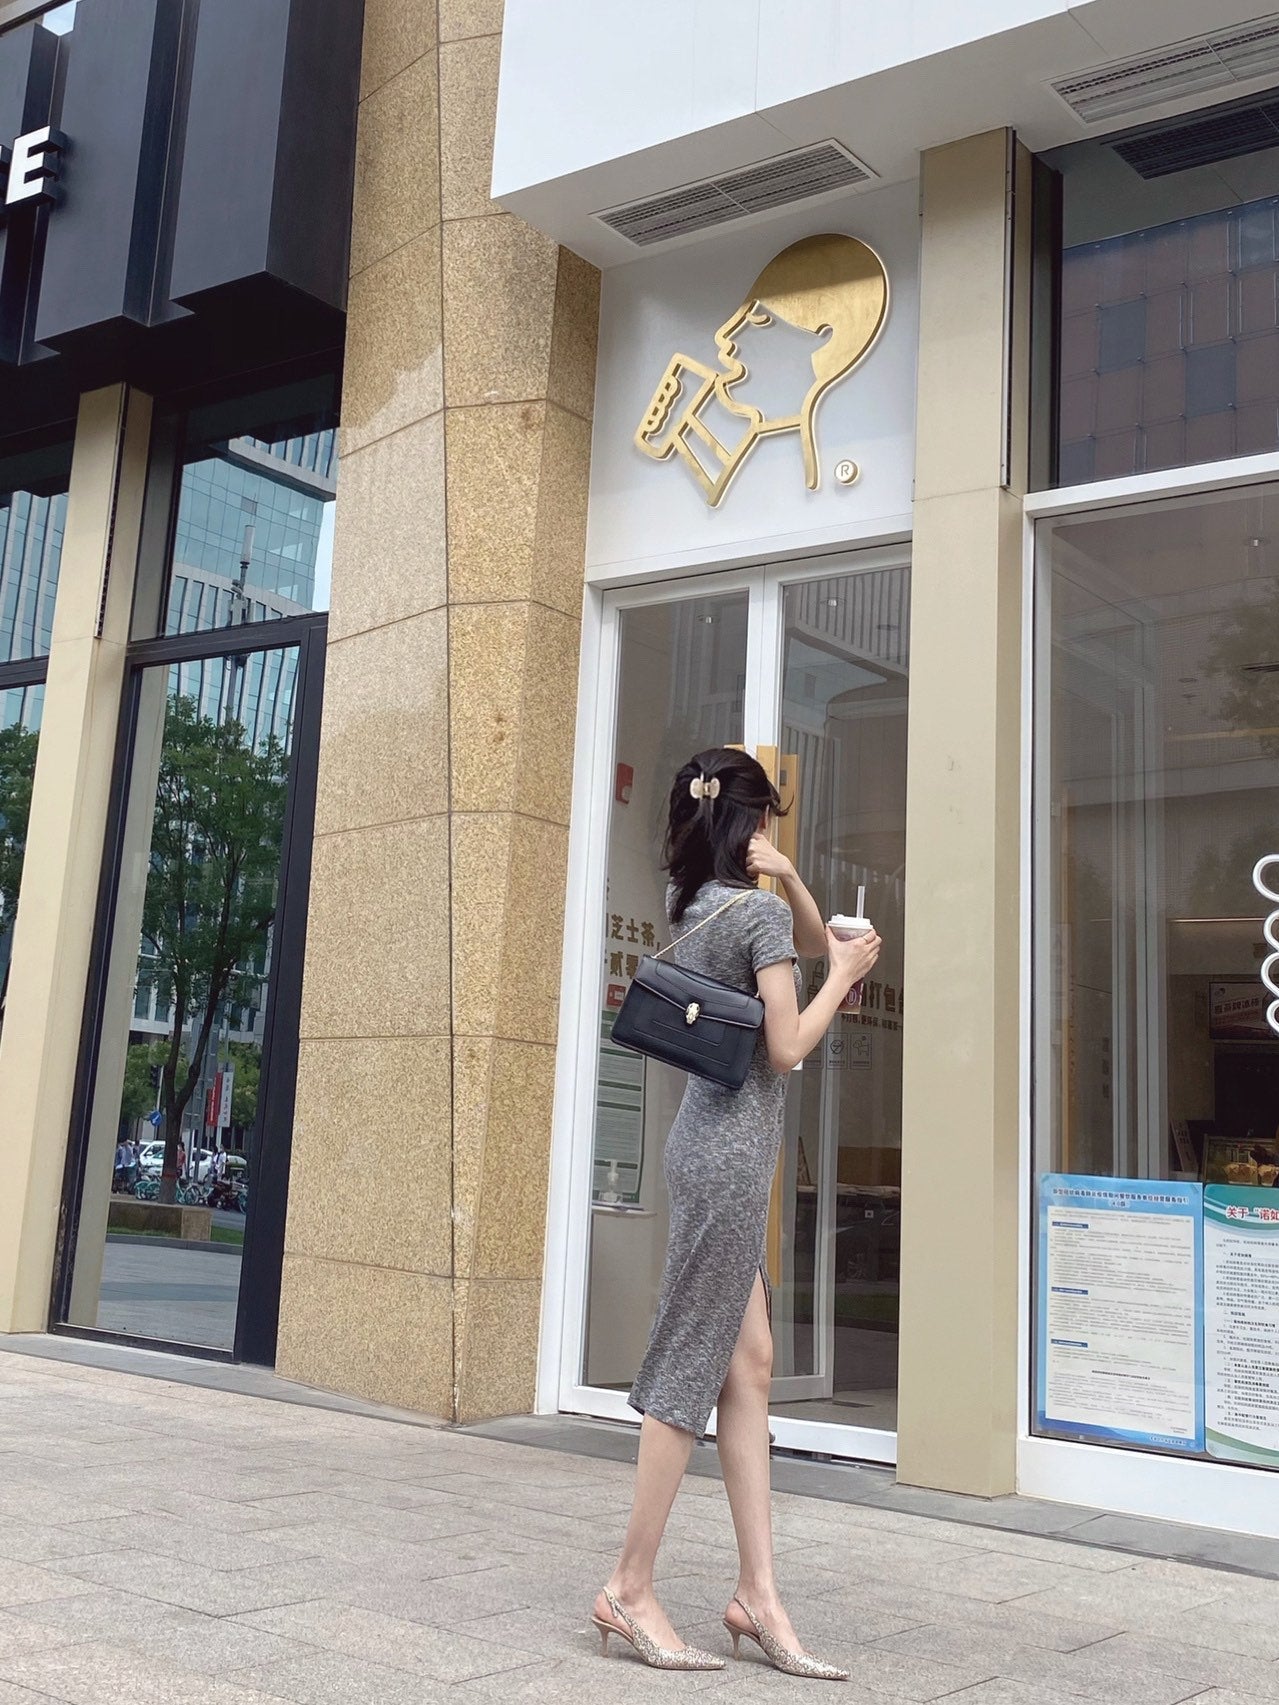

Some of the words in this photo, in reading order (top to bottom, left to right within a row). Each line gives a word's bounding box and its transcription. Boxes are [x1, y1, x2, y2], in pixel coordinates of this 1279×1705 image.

[0, 125, 50, 205] E
[606, 913, 660, 951] 芝士茶，
